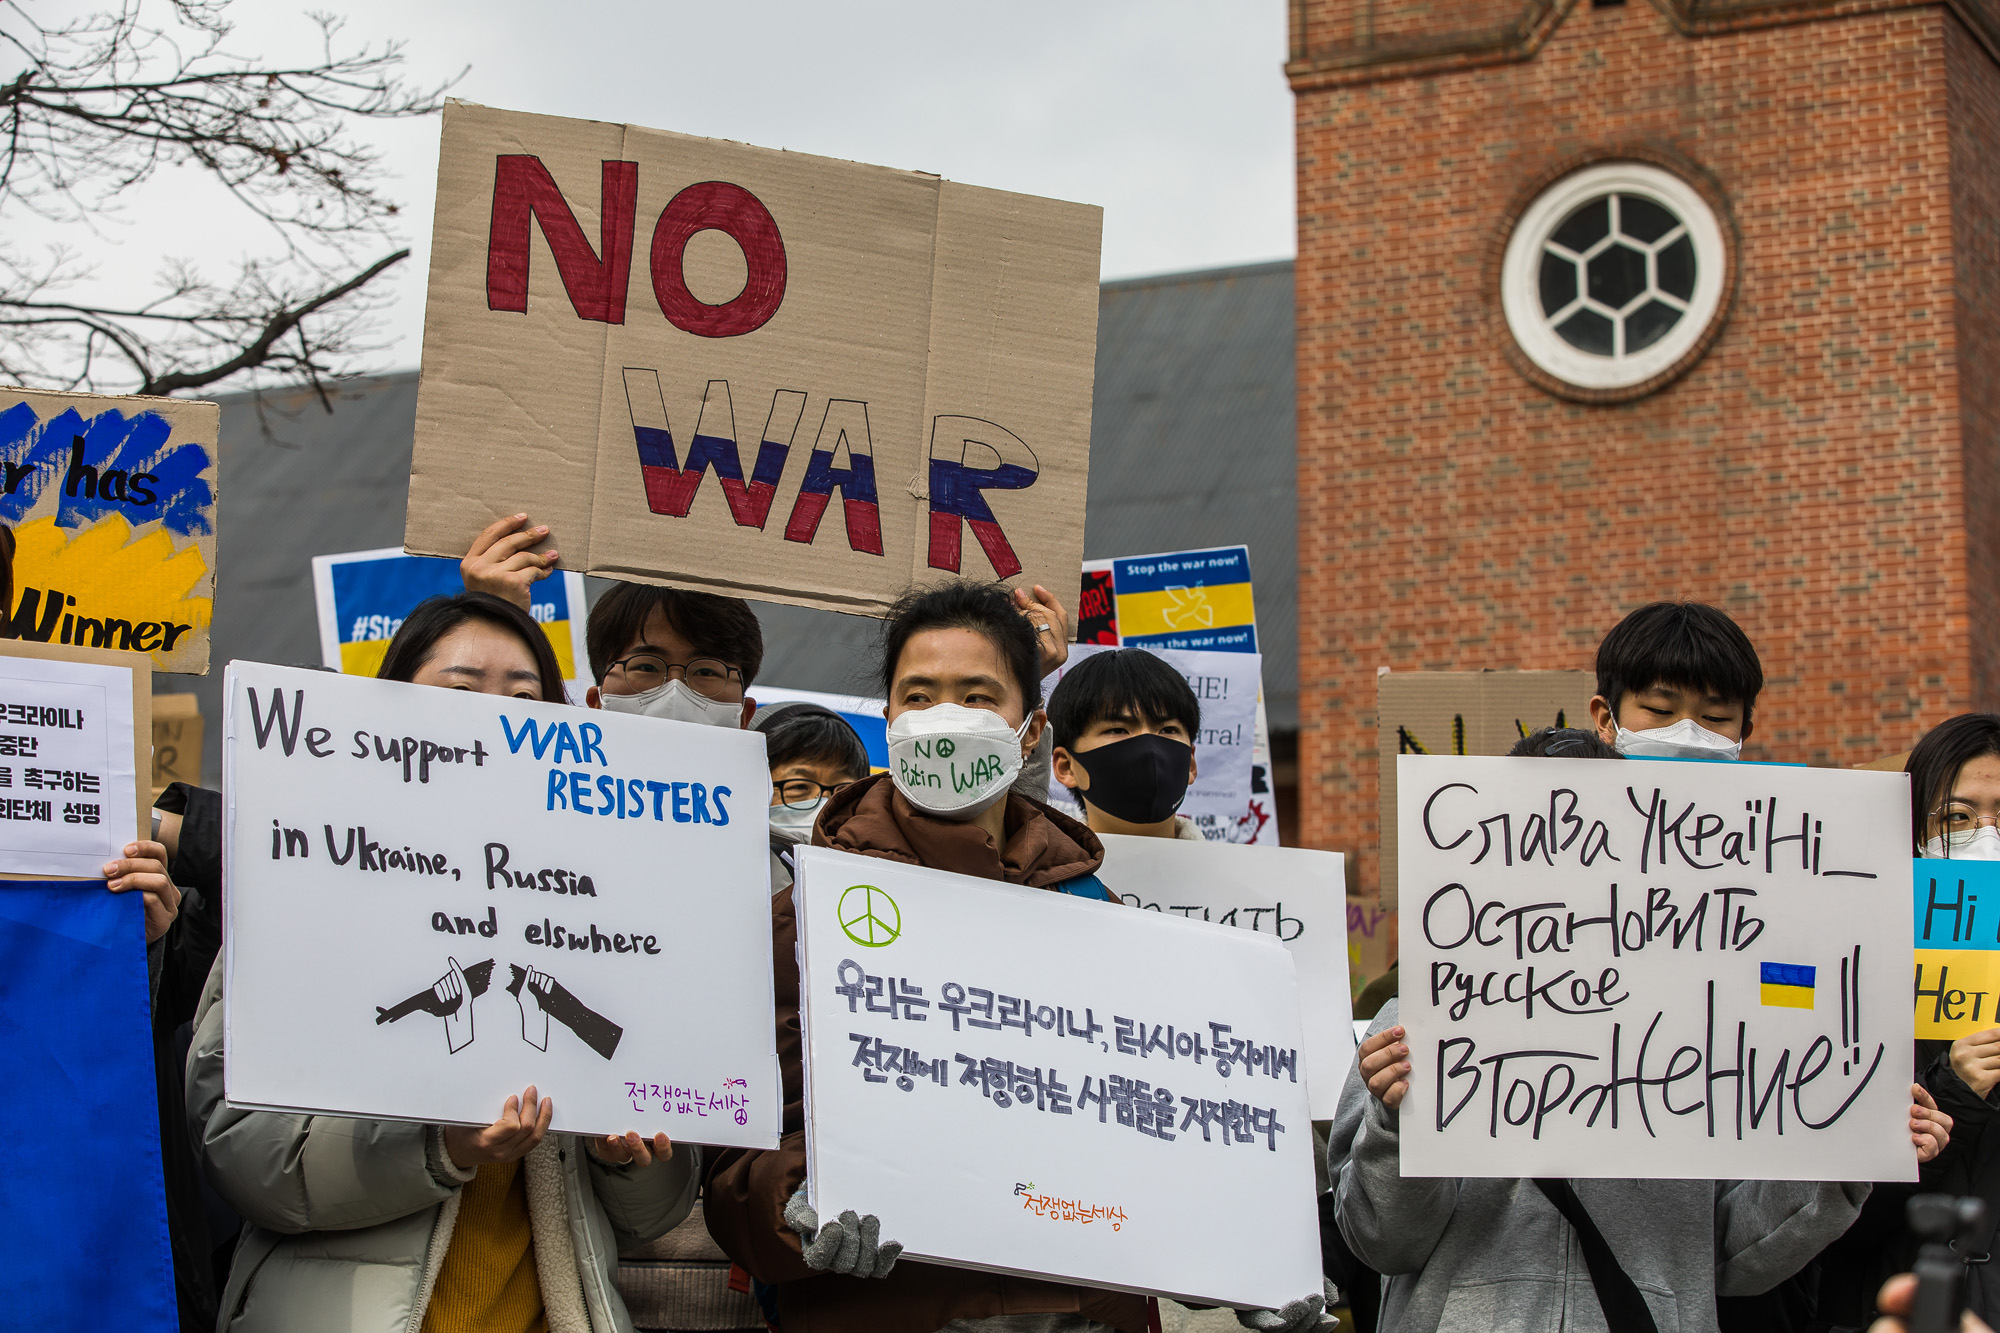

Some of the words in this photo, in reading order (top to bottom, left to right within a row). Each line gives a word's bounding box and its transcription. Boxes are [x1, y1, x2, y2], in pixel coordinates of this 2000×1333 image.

[486, 154, 788, 338] NO
[0, 461, 37, 495] r
[65, 434, 159, 506] has
[622, 367, 1040, 582] WAR
[1127, 563, 1156, 576] Stop
[1158, 559, 1180, 572] the
[1182, 557, 1206, 570] war
[1208, 554, 1239, 567] now!
[1079, 583, 1111, 621] AR!
[1166, 637, 1188, 649] the
[1190, 635, 1214, 648] war
[1216, 632, 1248, 646] now!
[0, 735, 38, 757] 중단
[247, 687, 335, 757] We
[351, 730, 489, 783] support
[499, 714, 607, 766] WAR
[24, 768, 100, 793] 촉구하는
[547, 768, 732, 826] RESISTERS
[900, 758, 941, 789] Putin
[950, 754, 1004, 793] WAR
[63, 802, 100, 825] 성명
[271, 819, 309, 861] in
[324, 824, 461, 881] Ukraine,
[484, 842, 598, 898] Russia
[432, 906, 498, 939] and
[524, 918, 662, 955] elswhere
[835, 958, 930, 1021] 우리는
[1914, 963, 1990, 1024] Нет
[849, 1032, 949, 1093] 전쟁에
[954, 1052, 1073, 1115] 저항하는
[1076, 1074, 1178, 1141] 사람들을
[1020, 1191, 1129, 1232] 전쟁없는세상
